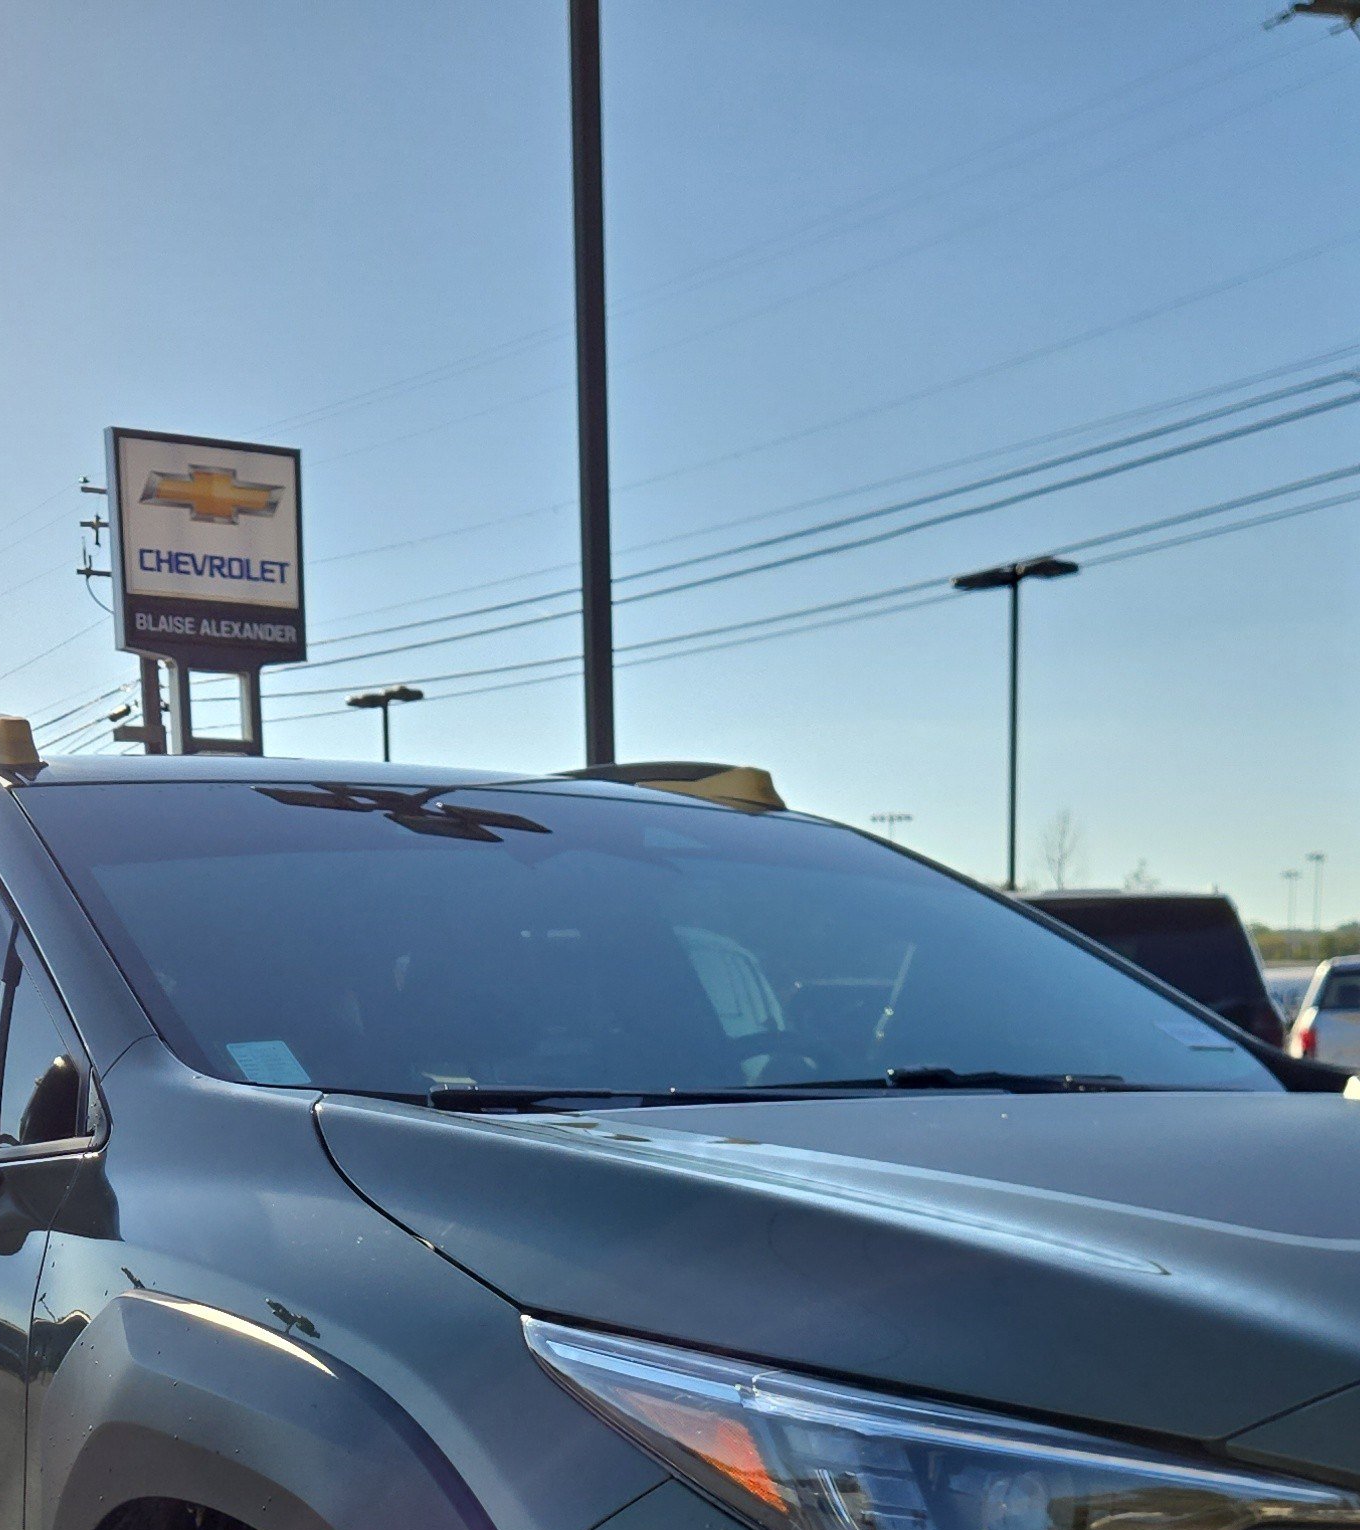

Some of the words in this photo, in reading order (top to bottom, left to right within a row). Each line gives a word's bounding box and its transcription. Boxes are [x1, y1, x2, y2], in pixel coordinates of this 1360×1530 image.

[139, 548, 290, 584] CHEVROLET
[135, 612, 195, 636] BLAISE
[199, 618, 297, 643] ALEXANDER
